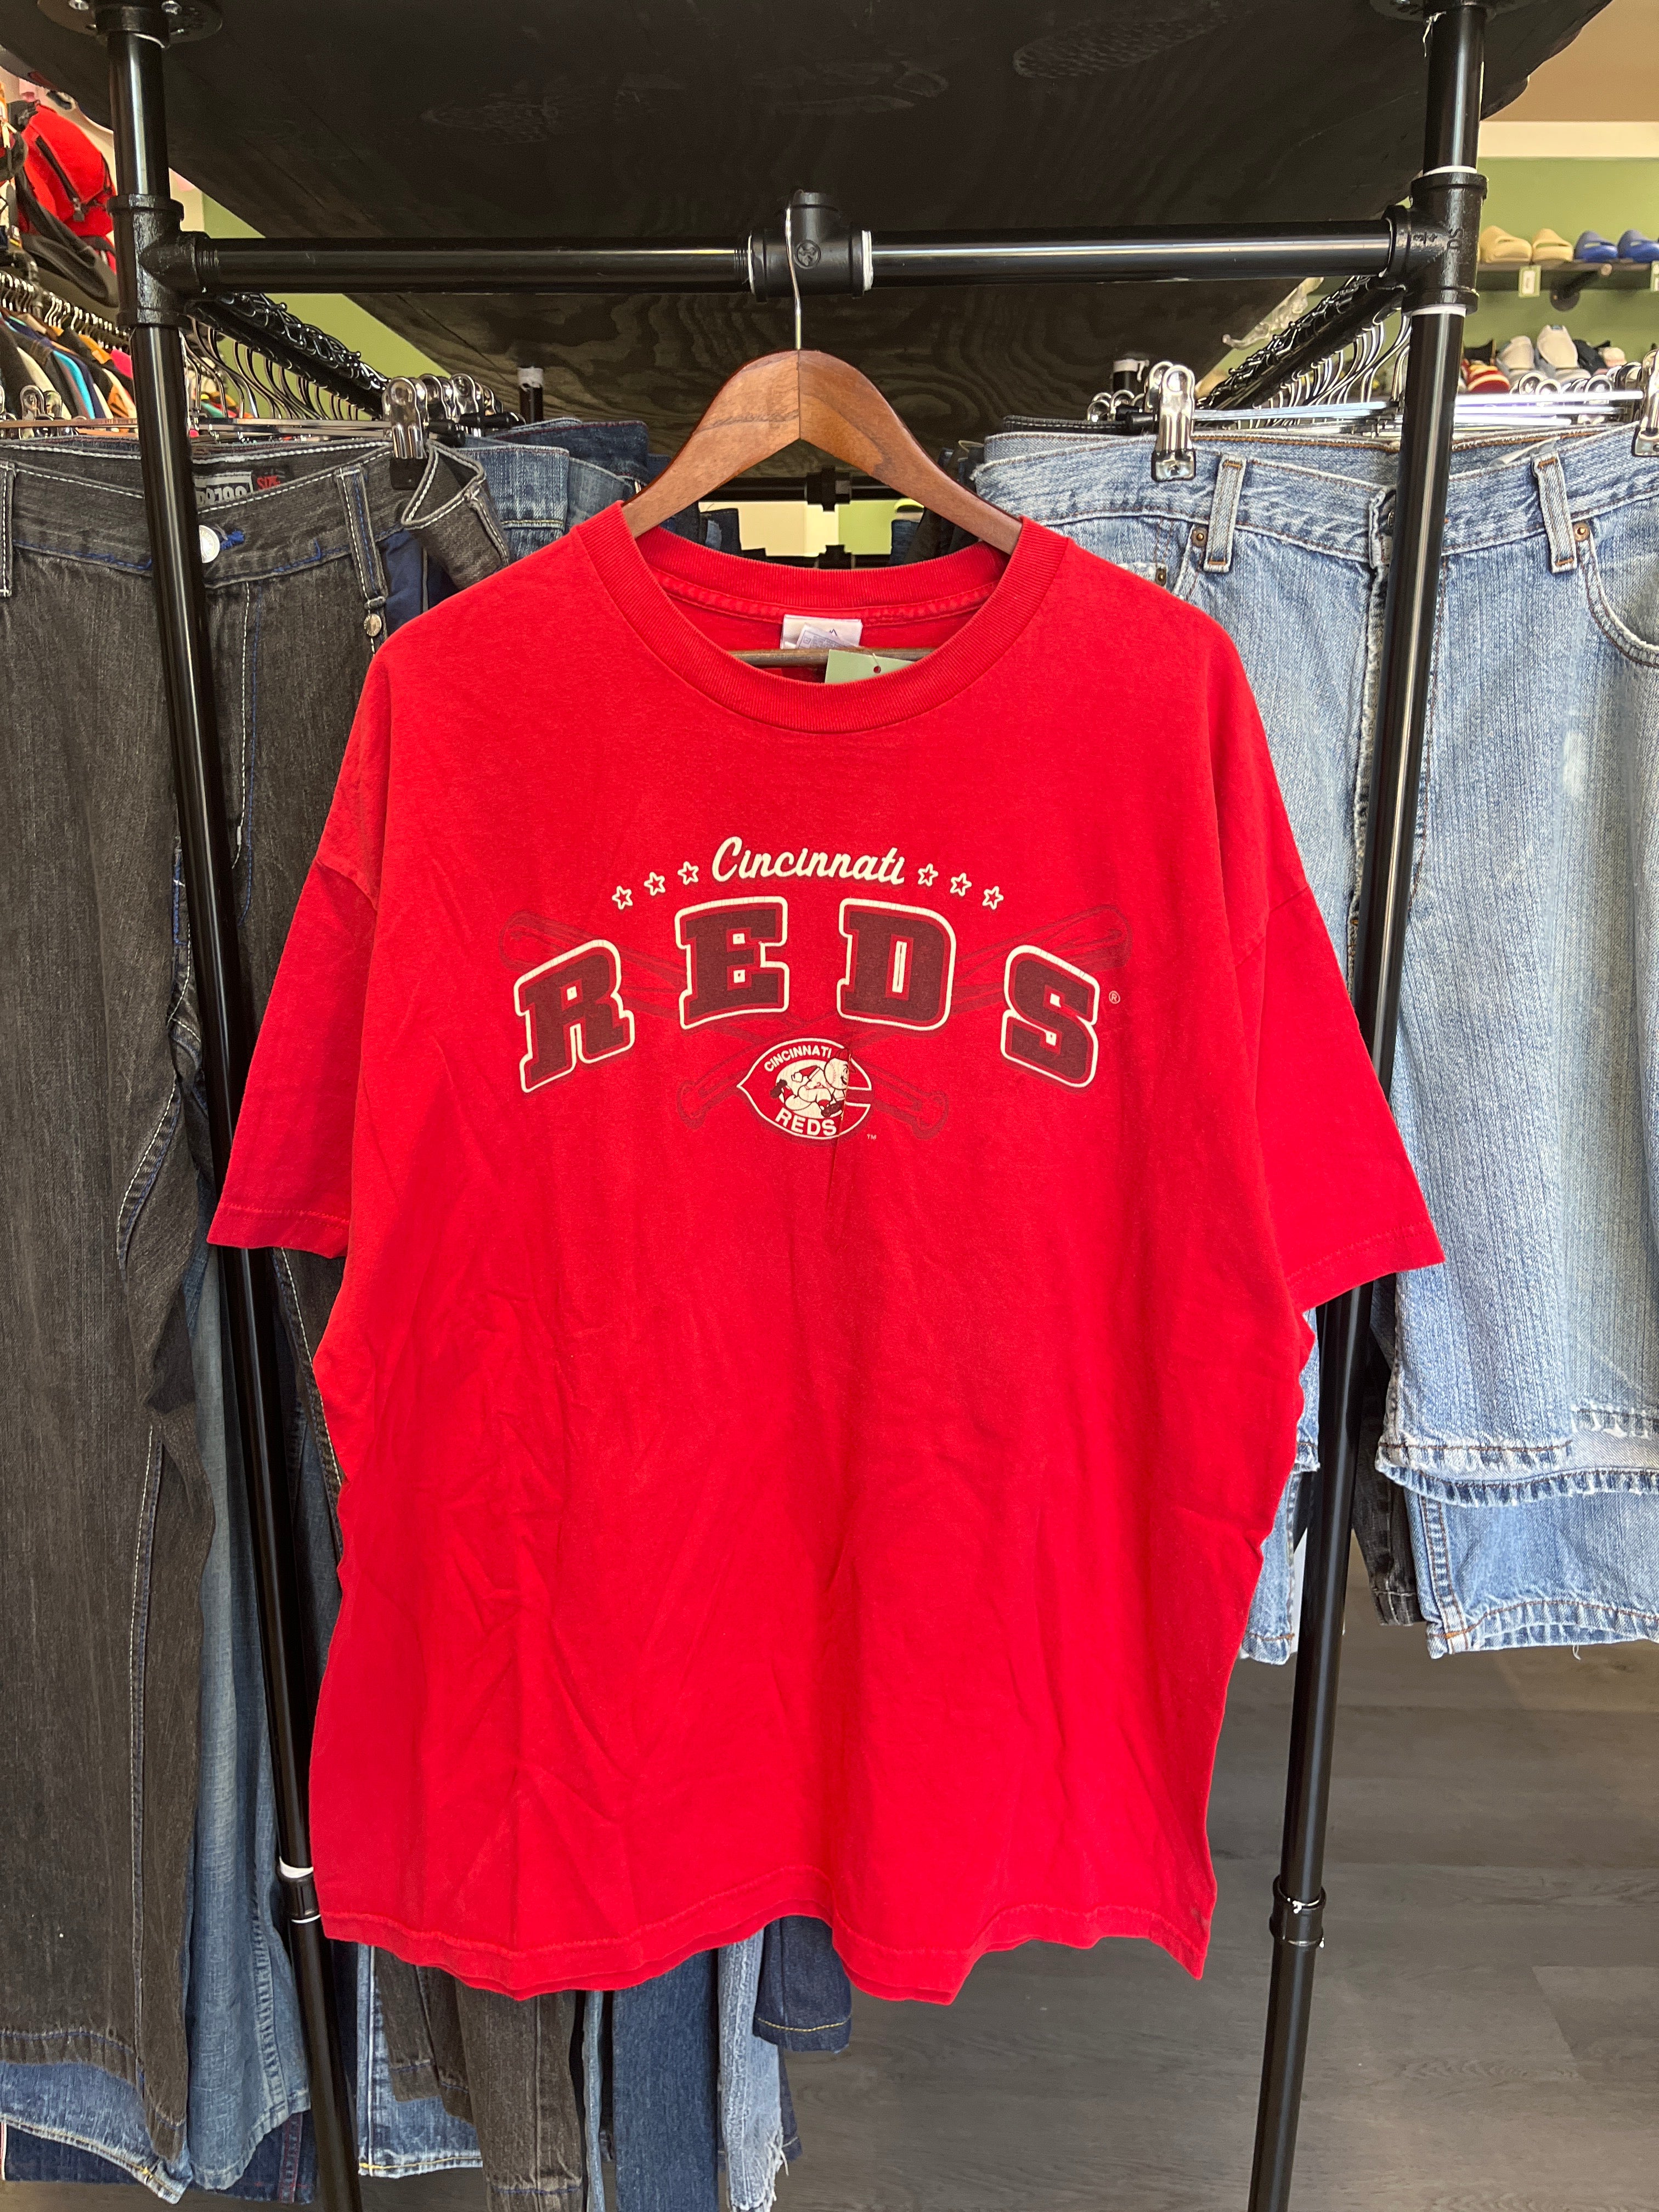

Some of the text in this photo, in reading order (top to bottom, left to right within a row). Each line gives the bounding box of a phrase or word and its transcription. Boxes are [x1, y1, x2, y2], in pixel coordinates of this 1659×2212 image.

[712, 836, 905, 885] Cincinnati
[514, 895, 1101, 1093] REDS
[764, 1045, 832, 1072] CINCINNATI
[775, 1107, 837, 1137] REDS
